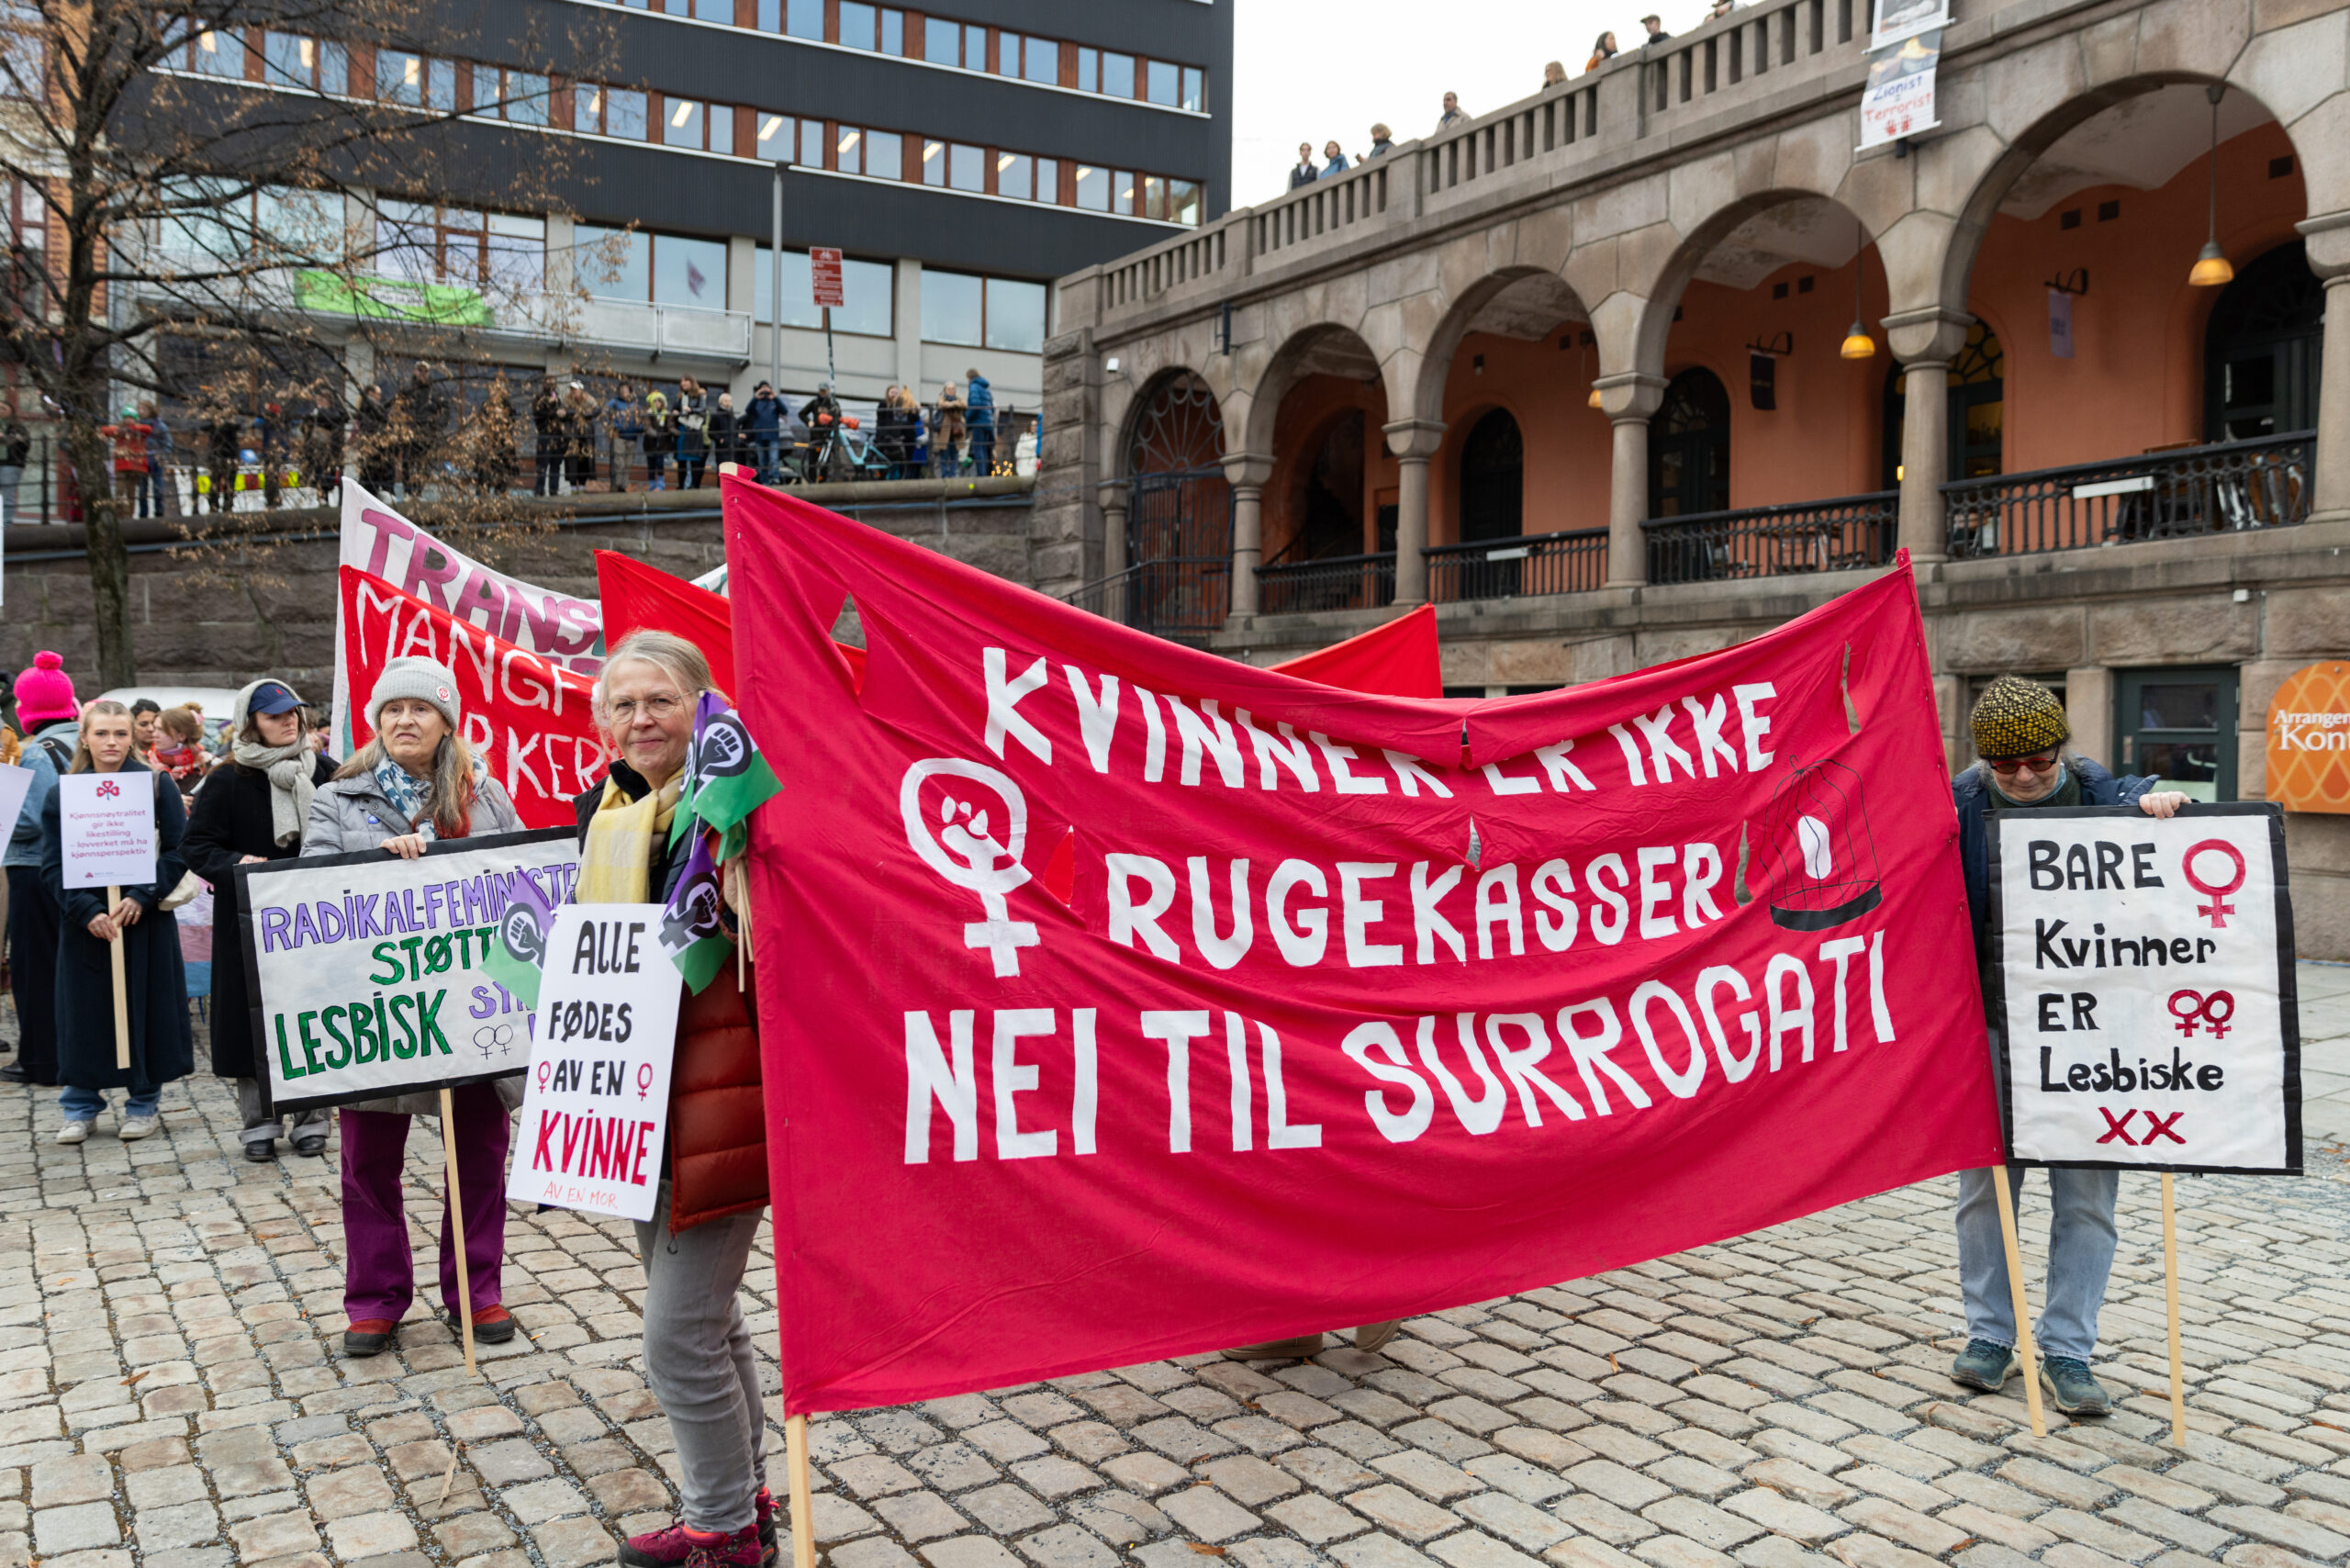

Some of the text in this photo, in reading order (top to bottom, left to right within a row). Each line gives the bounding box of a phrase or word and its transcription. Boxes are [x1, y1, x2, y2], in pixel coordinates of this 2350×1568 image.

[1864, 92, 1932, 122] Terrorist
[1873, 75, 1923, 101] Zionist
[1606, 681, 1777, 787] IKKE
[69, 810, 146, 820] Kjønnsnøytralitet
[86, 829, 131, 837] likestilling
[71, 847, 148, 858] kjønnsperspektiv
[77, 839, 118, 847] lovverket
[120, 837, 134, 846] må
[2028, 839, 2165, 891] BARE
[1106, 842, 1724, 969] RUGEKASSER
[369, 925, 499, 986] STØTT
[572, 920, 646, 975] ALLE
[2035, 918, 2217, 969] Kvinner
[548, 999, 632, 1043] FØDES
[2038, 991, 2101, 1033] ER
[274, 991, 453, 1081] LESBISK
[903, 929, 1896, 1164] NEI TIL SURROGATI
[553, 1058, 626, 1096] AV EN
[2040, 1046, 2224, 1092] Lesbiske
[532, 1108, 655, 1186] KVINNE
[543, 1181, 618, 1210] AV EN MOR
